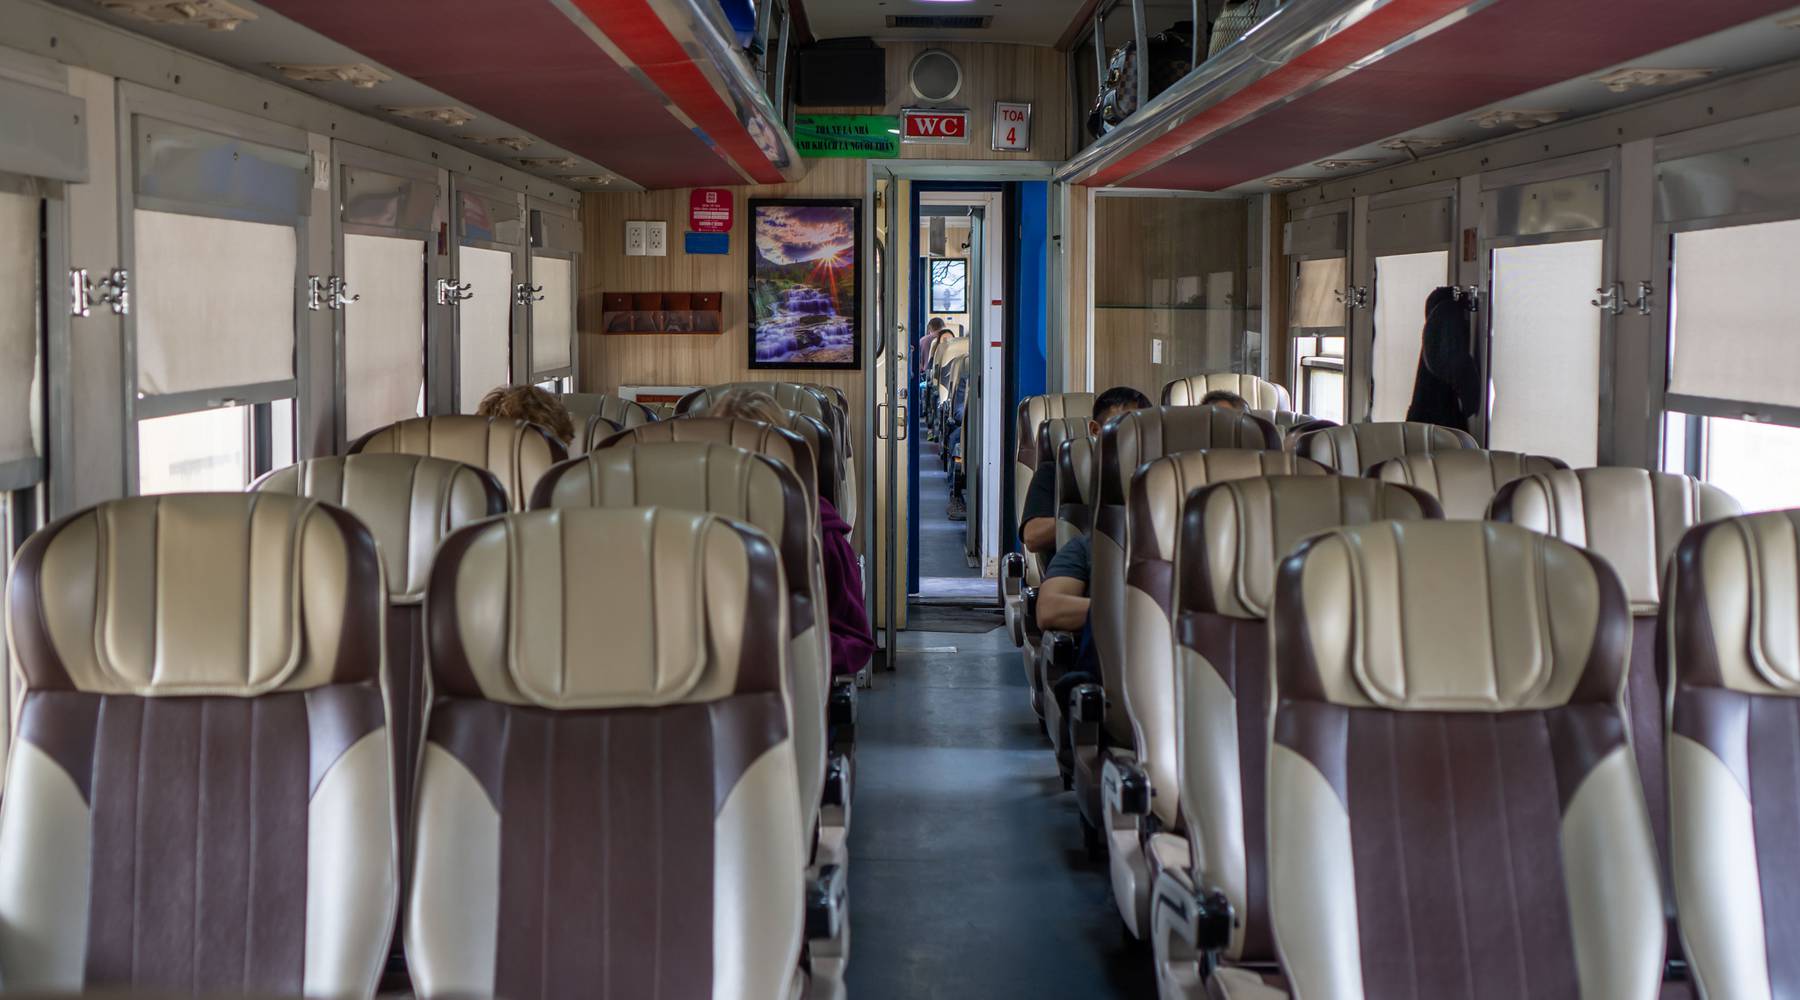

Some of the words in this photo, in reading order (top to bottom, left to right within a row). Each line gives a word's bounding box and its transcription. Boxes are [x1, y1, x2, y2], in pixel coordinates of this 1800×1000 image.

[1002, 110, 1024, 121] TOA
[915, 117, 958, 135] WC
[1006, 127, 1017, 145] 4
